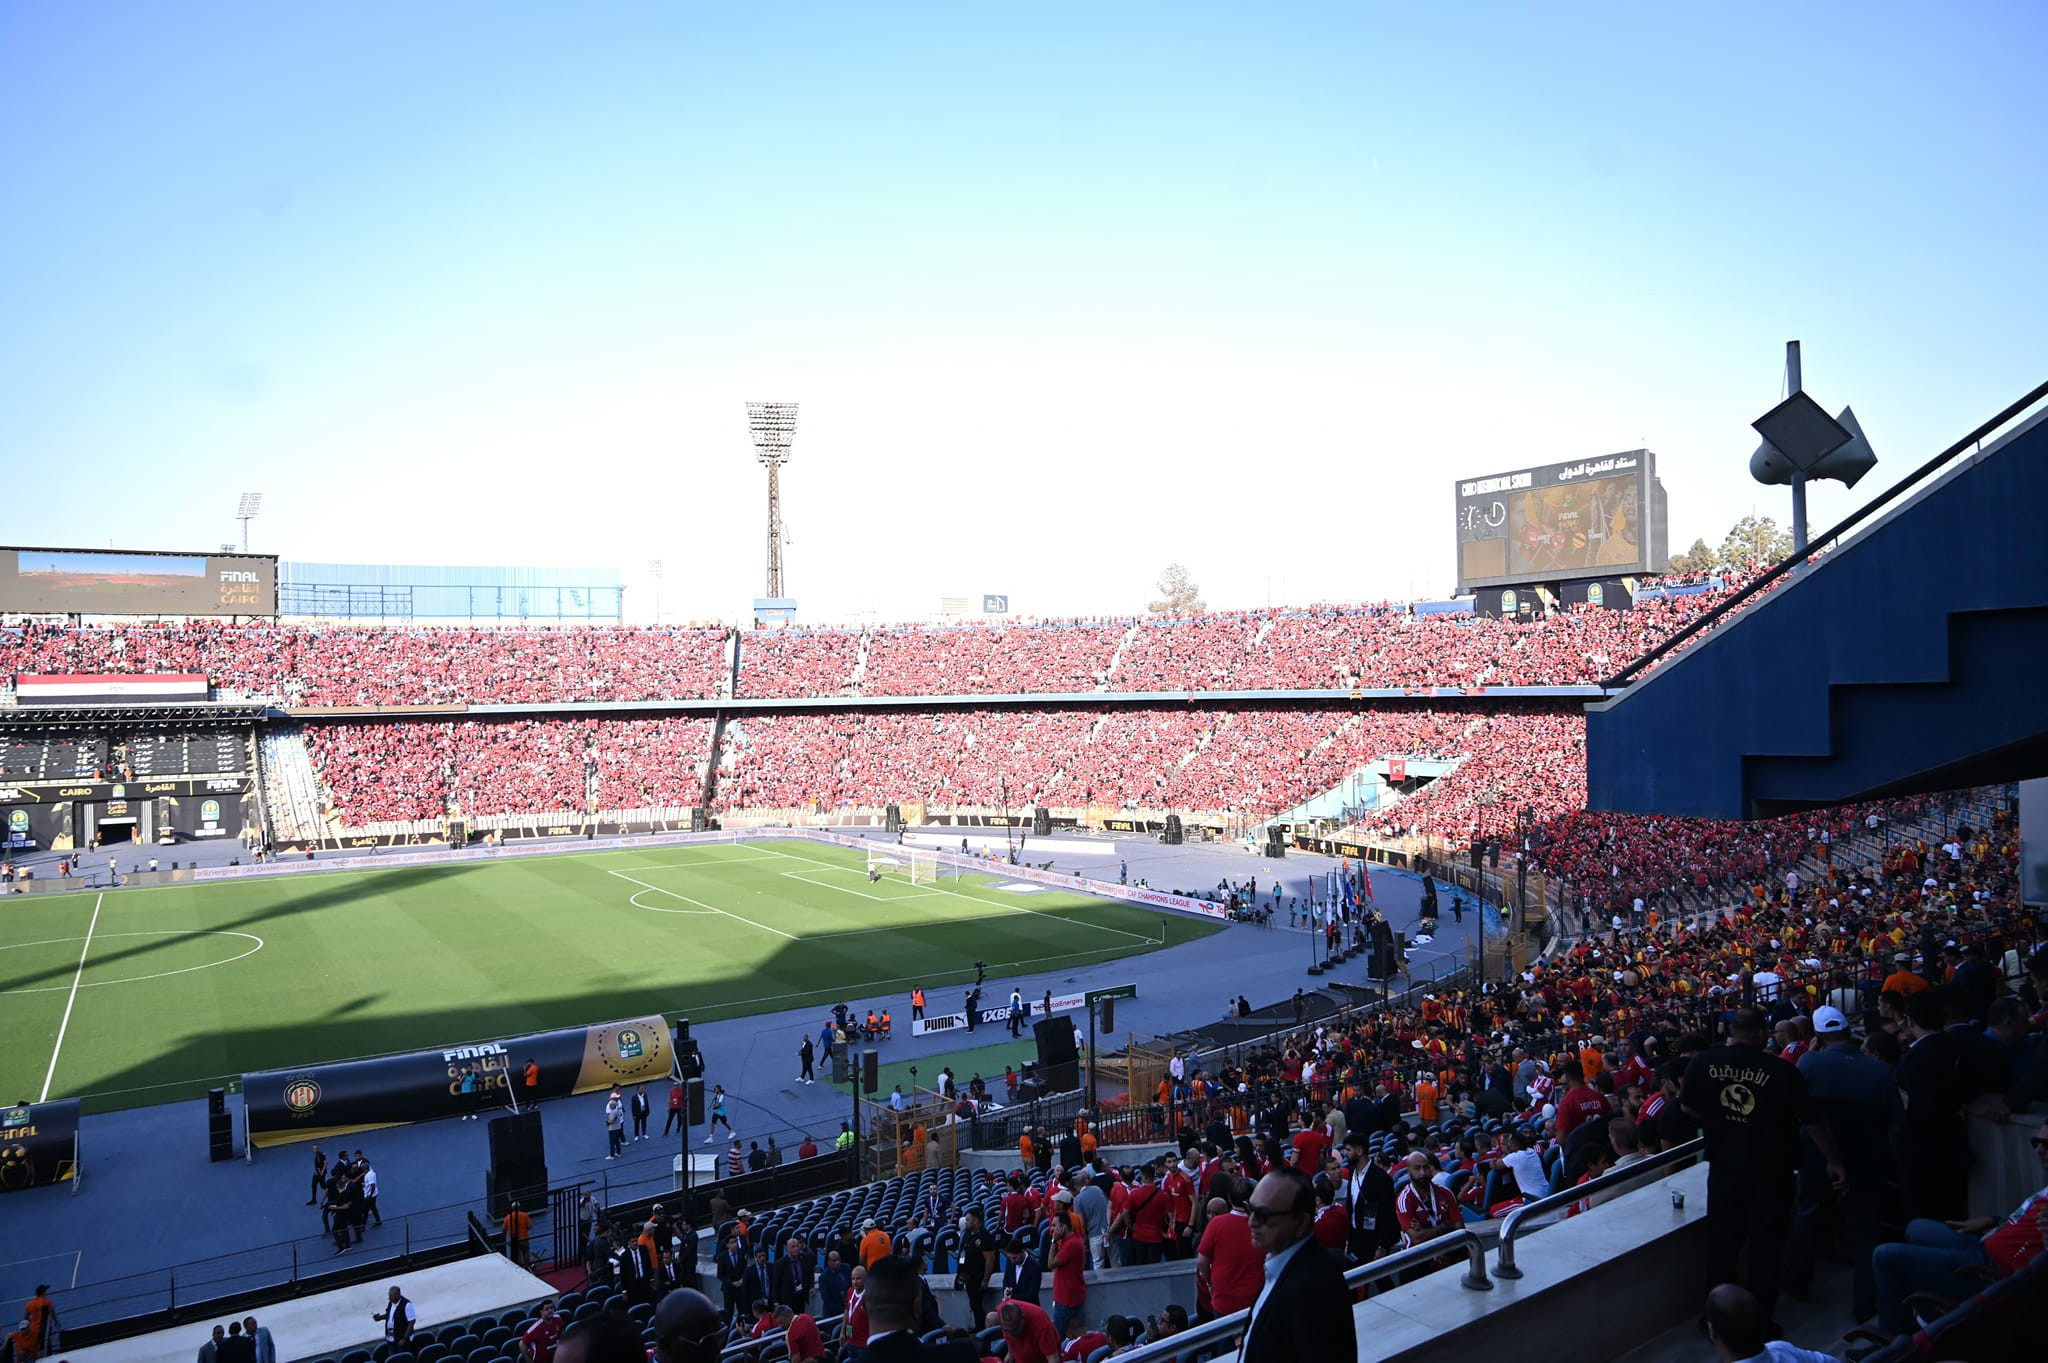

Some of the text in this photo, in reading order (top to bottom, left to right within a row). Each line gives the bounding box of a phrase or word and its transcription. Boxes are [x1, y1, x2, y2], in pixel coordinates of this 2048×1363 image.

[220, 595, 260, 605] CAIRO
[59, 787, 93, 797] CAIRO
[1127, 889, 1137, 898] CAF
[1138, 891, 1169, 904] CHAMPIONS
[1169, 896, 1191, 909] LEAGUE
[1049, 997, 1084, 1010] otalEnergies
[982, 1006, 1012, 1023] 1XBE
[924, 1015, 955, 1032] PUMA
[1708, 1064, 1770, 1087] الأفريقية
